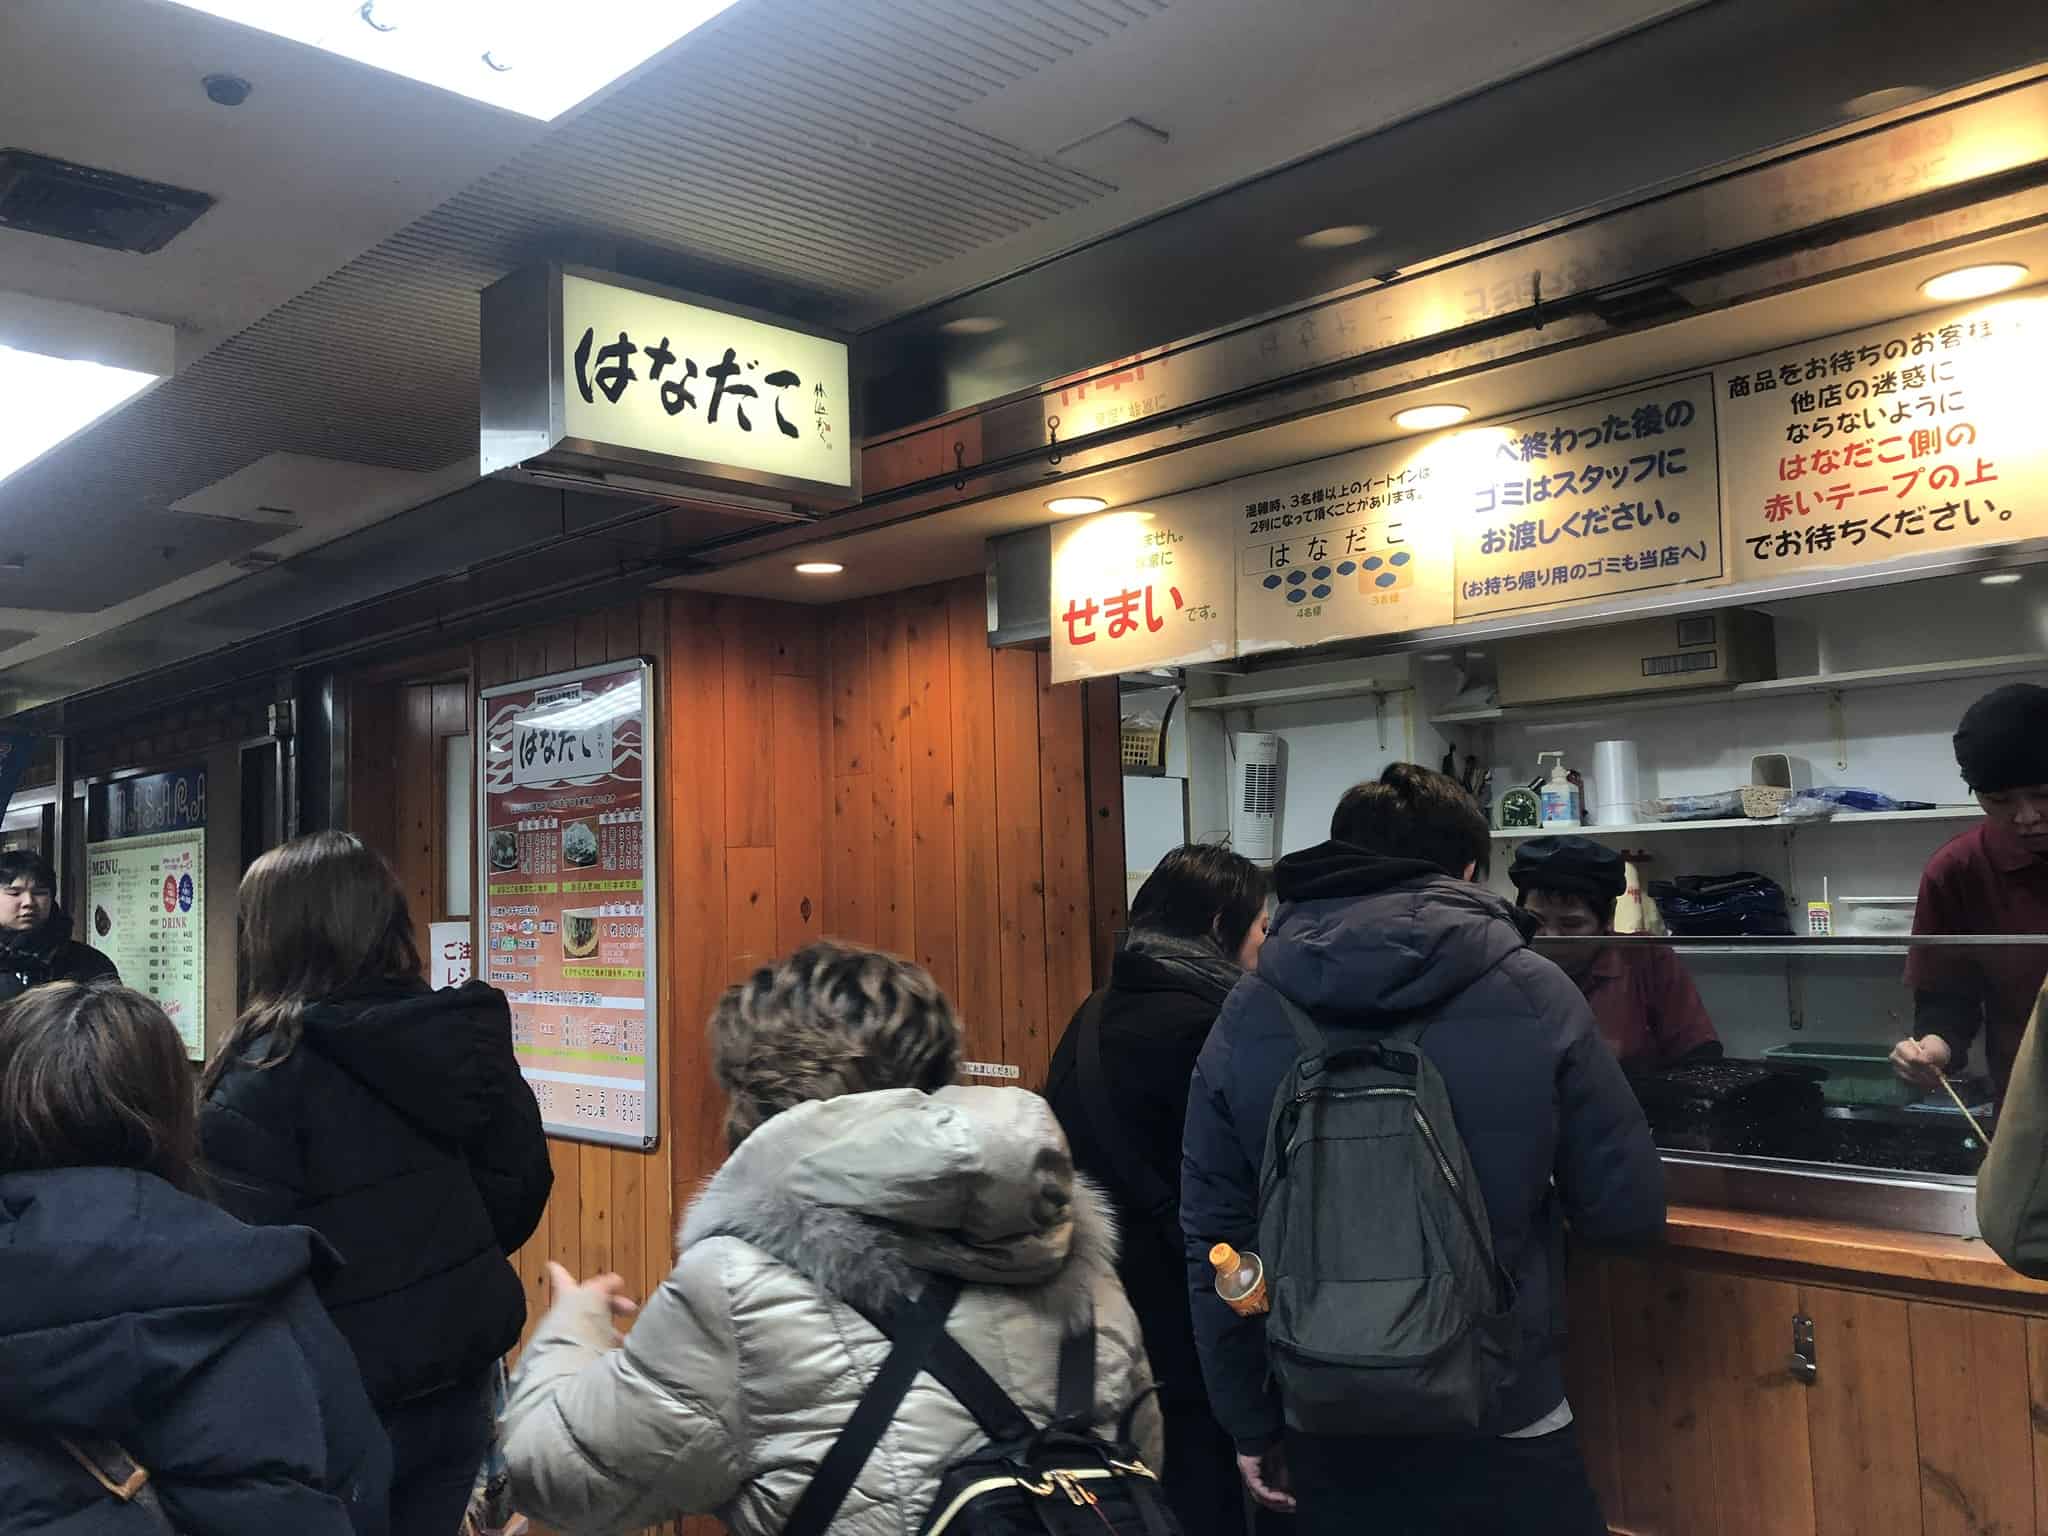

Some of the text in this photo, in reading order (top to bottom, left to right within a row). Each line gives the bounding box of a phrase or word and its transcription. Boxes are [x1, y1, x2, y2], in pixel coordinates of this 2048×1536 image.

[574, 327, 802, 439] はなだこ
[1790, 361, 1955, 415] 他店の迷惑に
[1785, 391, 1965, 444] ならないように
[1475, 448, 1688, 513] ゴミはスタッフに
[1778, 422, 1976, 481] はなだこ側の
[1764, 457, 1999, 523] 赤いテープの上
[1481, 500, 1680, 555] お渡しください。
[1745, 499, 2013, 560] でお待ちください。
[1062, 585, 1184, 645] せまい
[92, 858, 119, 876] MENU
[162, 916, 188, 929] DRINK
